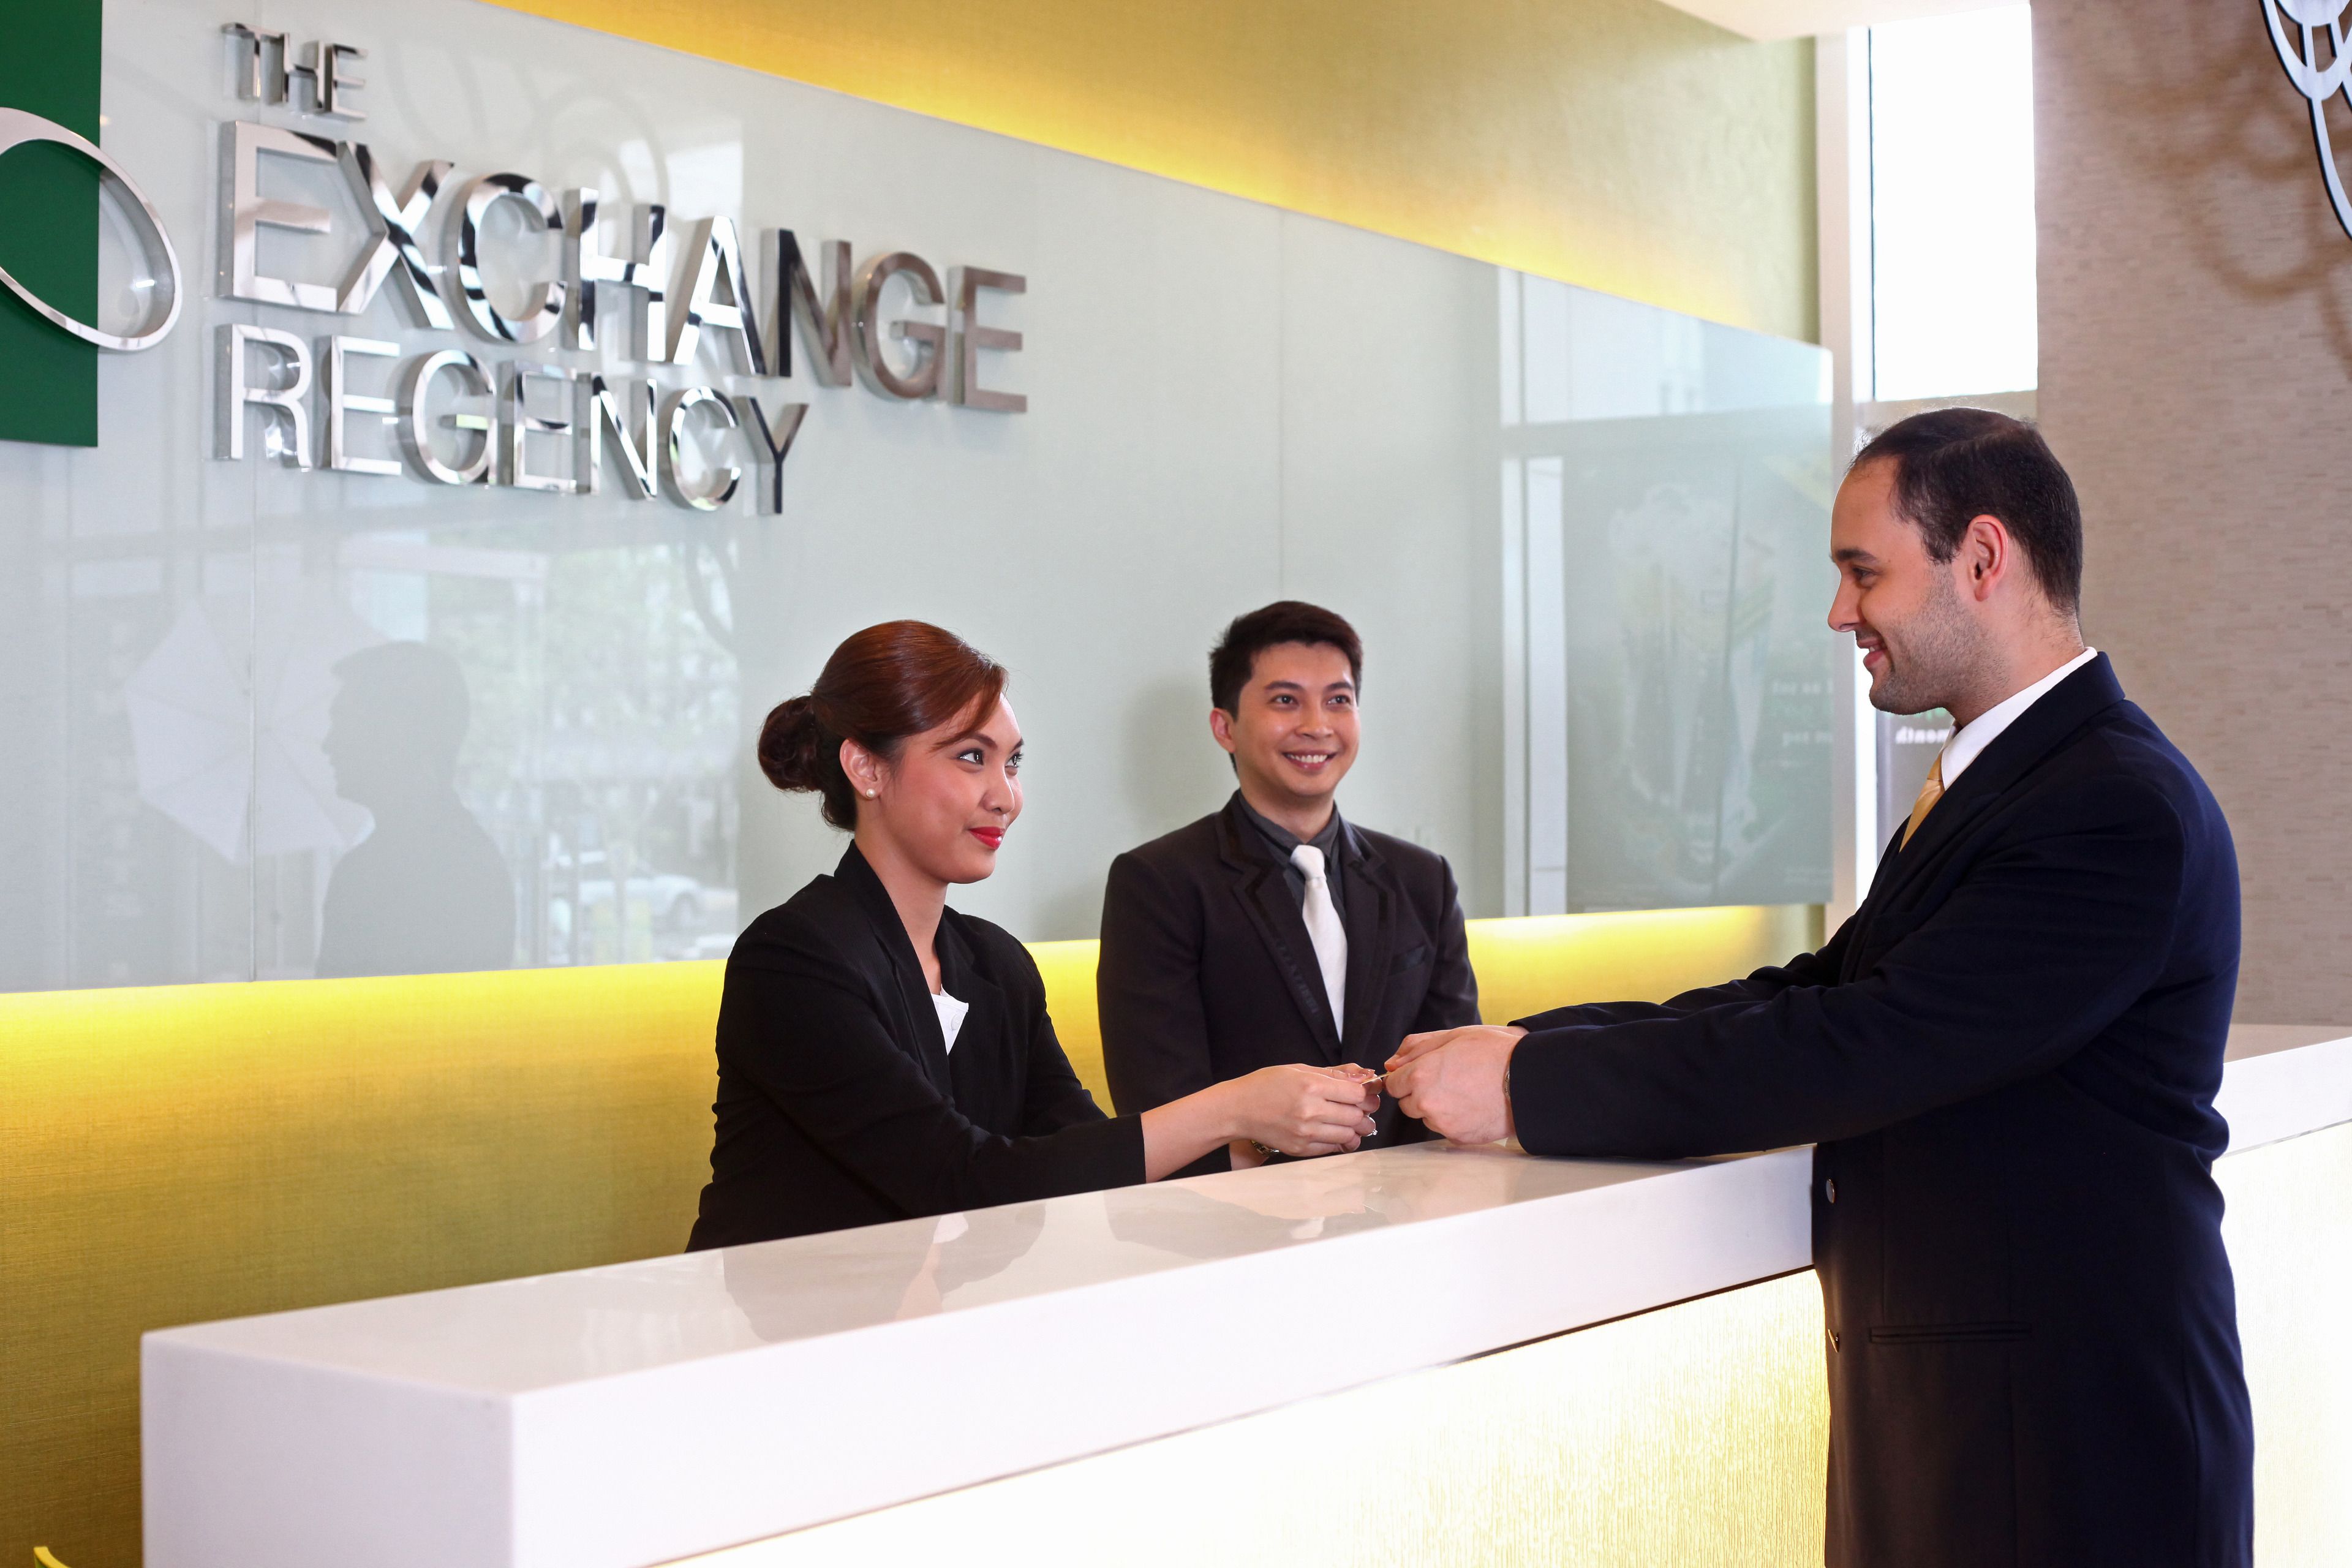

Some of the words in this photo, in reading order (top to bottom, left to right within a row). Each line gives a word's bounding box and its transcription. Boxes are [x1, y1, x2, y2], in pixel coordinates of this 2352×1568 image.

[221, 23, 368, 121] THE
[219, 121, 1027, 413] EXCHANGE
[217, 324, 809, 515] REGENCY
